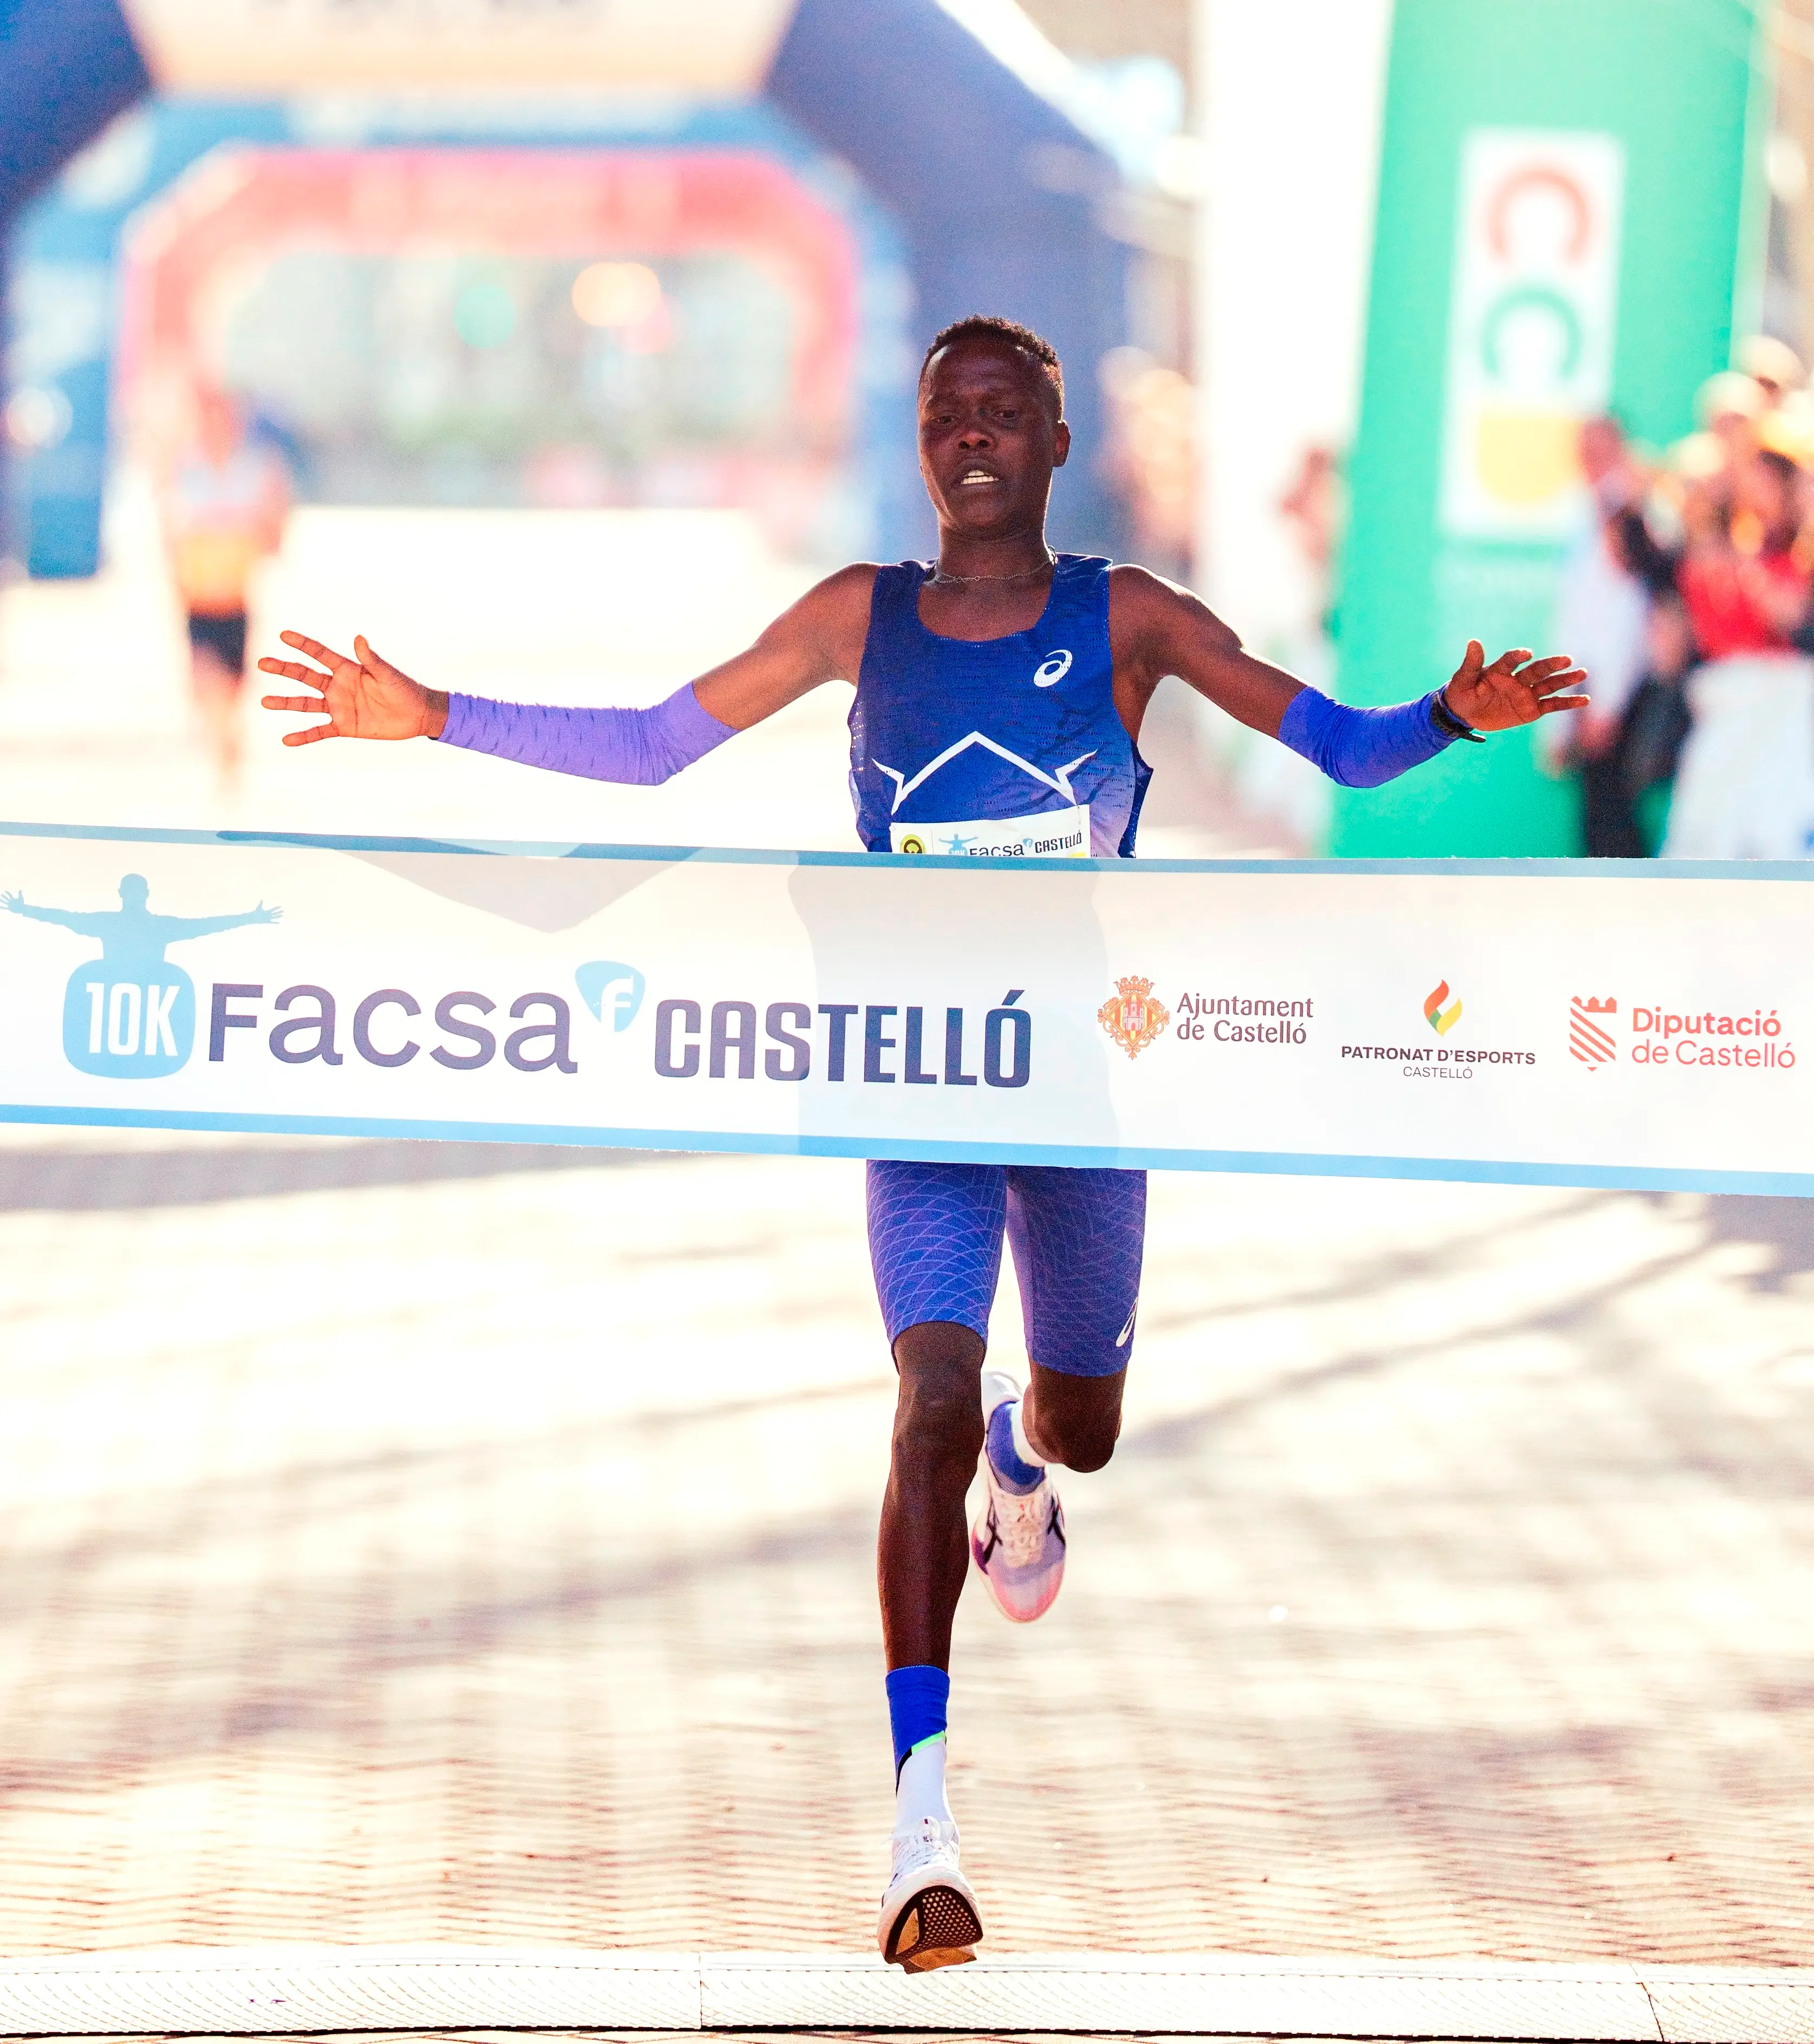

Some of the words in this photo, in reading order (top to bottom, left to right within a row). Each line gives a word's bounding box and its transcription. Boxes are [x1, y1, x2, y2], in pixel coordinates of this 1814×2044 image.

[969, 844, 1024, 856] Facsa
[1035, 829, 1081, 853] CASTELLÓ
[1177, 992, 1314, 1021] Ajuntament
[86, 982, 180, 1057] 10K
[209, 983, 578, 1074] Facsa
[655, 990, 1032, 1088] CASTELLÓ
[1177, 1017, 1204, 1040] de
[1214, 1020, 1307, 1044] Castelló
[1633, 1006, 1781, 1039] Diputació
[1342, 1046, 1434, 1061] PATRONAT
[1632, 1039, 1669, 1064] de
[1676, 1040, 1796, 1068] Castelló
[1403, 1066, 1473, 1079] CASTELLÓ
